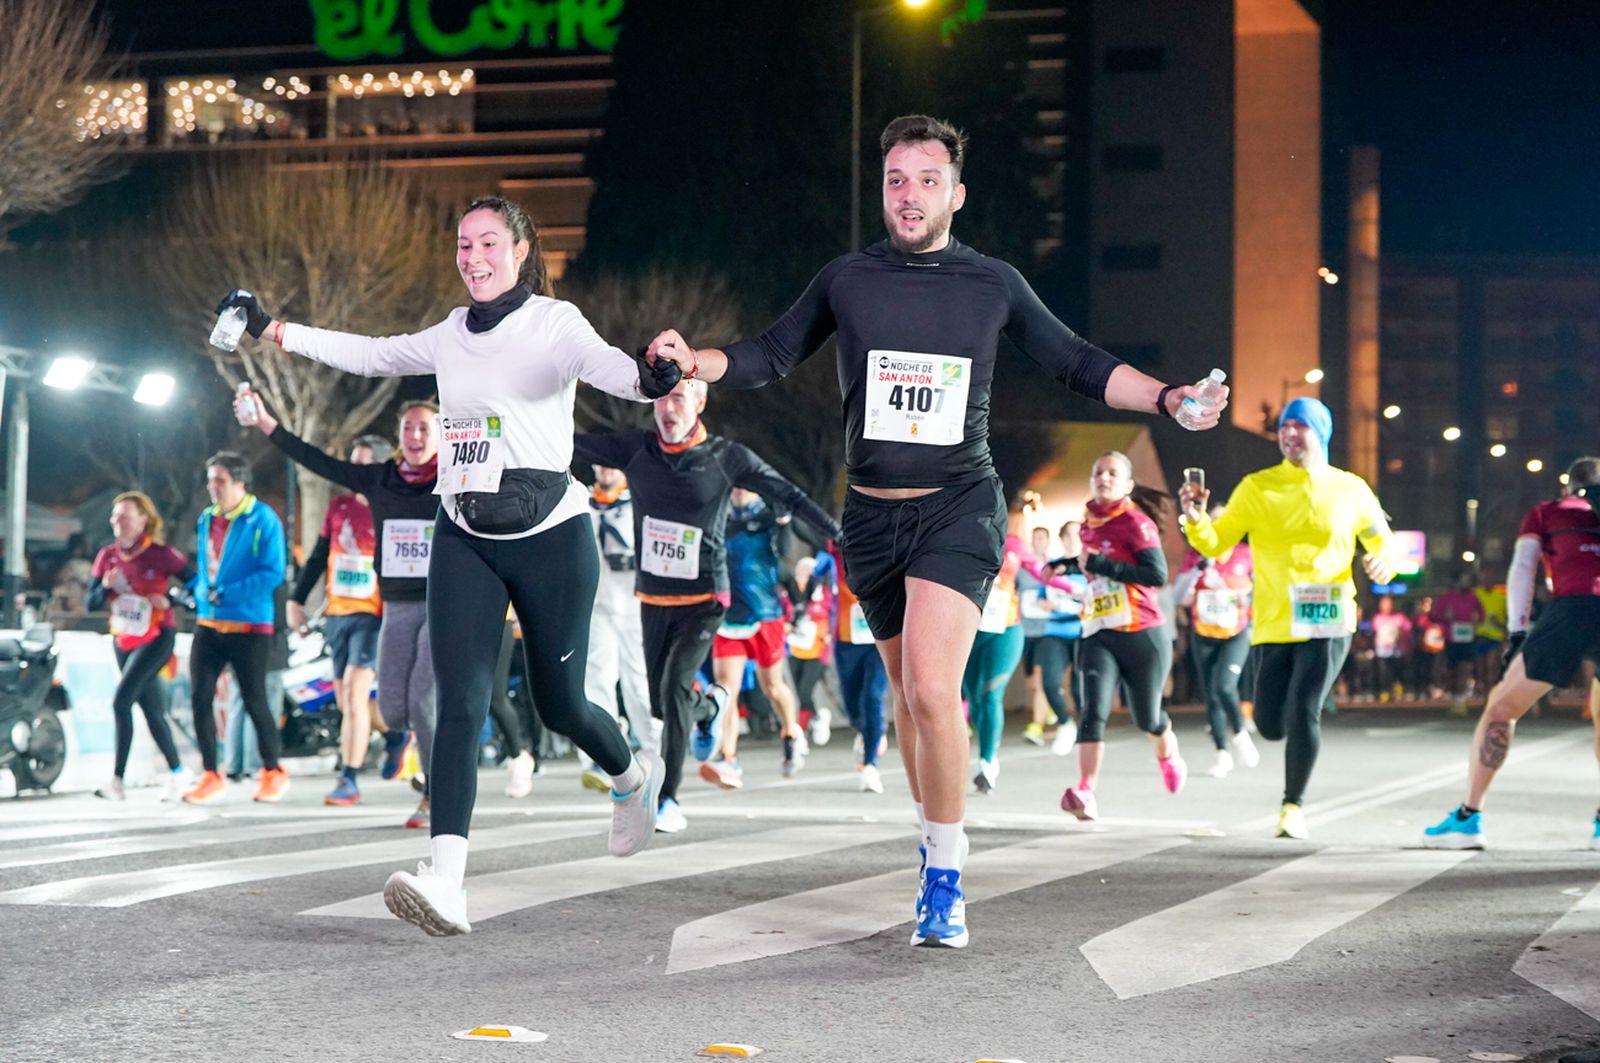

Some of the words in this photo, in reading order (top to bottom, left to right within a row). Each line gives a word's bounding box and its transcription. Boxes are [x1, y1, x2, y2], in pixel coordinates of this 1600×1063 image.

[890, 361, 921, 373] NOCHE
[922, 364, 934, 374] DE
[879, 371, 898, 383] SAN
[888, 384, 946, 414] 4107
[452, 420, 473, 429] NOCHE
[444, 431, 459, 441] SAN
[452, 440, 490, 466] 7480
[394, 541, 429, 558] 7663
[652, 540, 686, 560] 4756
[1088, 593, 1119, 613] 331
[1300, 603, 1338, 619] 13120
